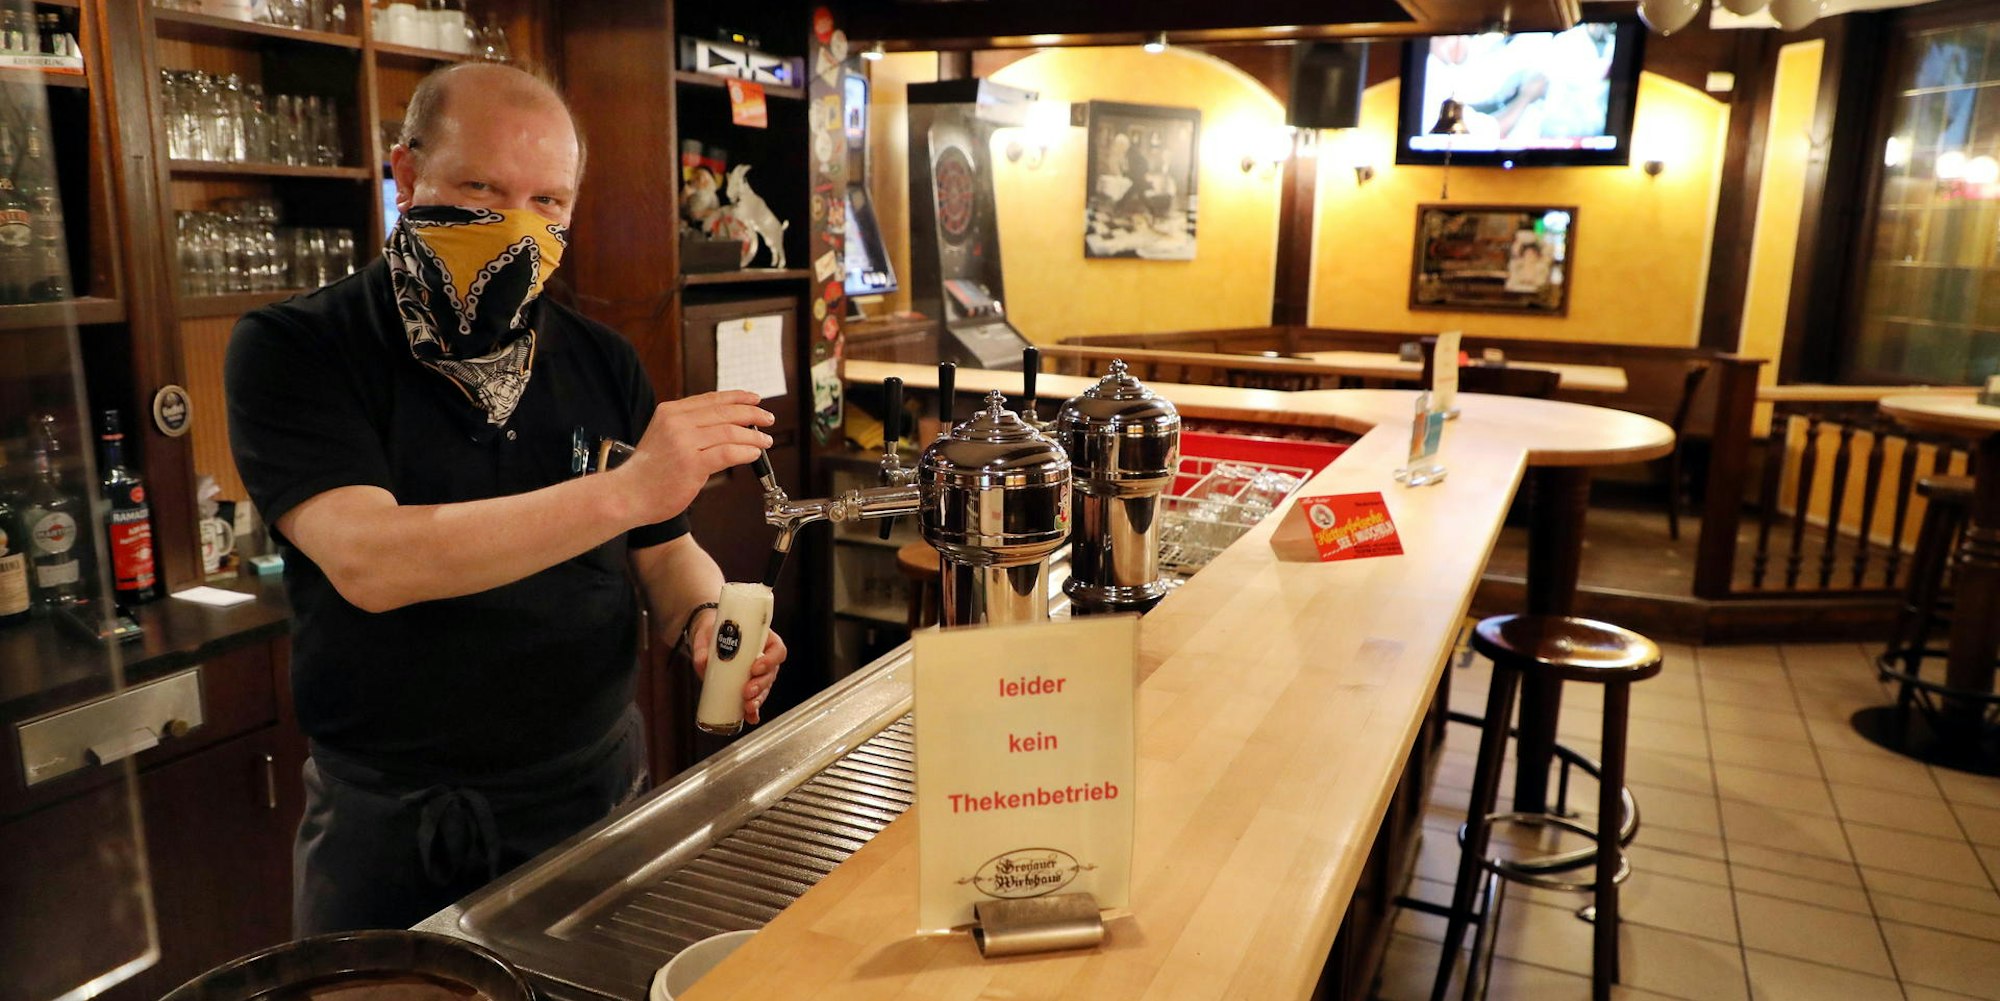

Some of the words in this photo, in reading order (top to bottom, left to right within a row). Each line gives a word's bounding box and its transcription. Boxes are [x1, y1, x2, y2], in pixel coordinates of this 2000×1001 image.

[999, 675, 1066, 697] leider
[1008, 732, 1058, 753] kein
[948, 781, 1119, 814] Thekenbetrieb
